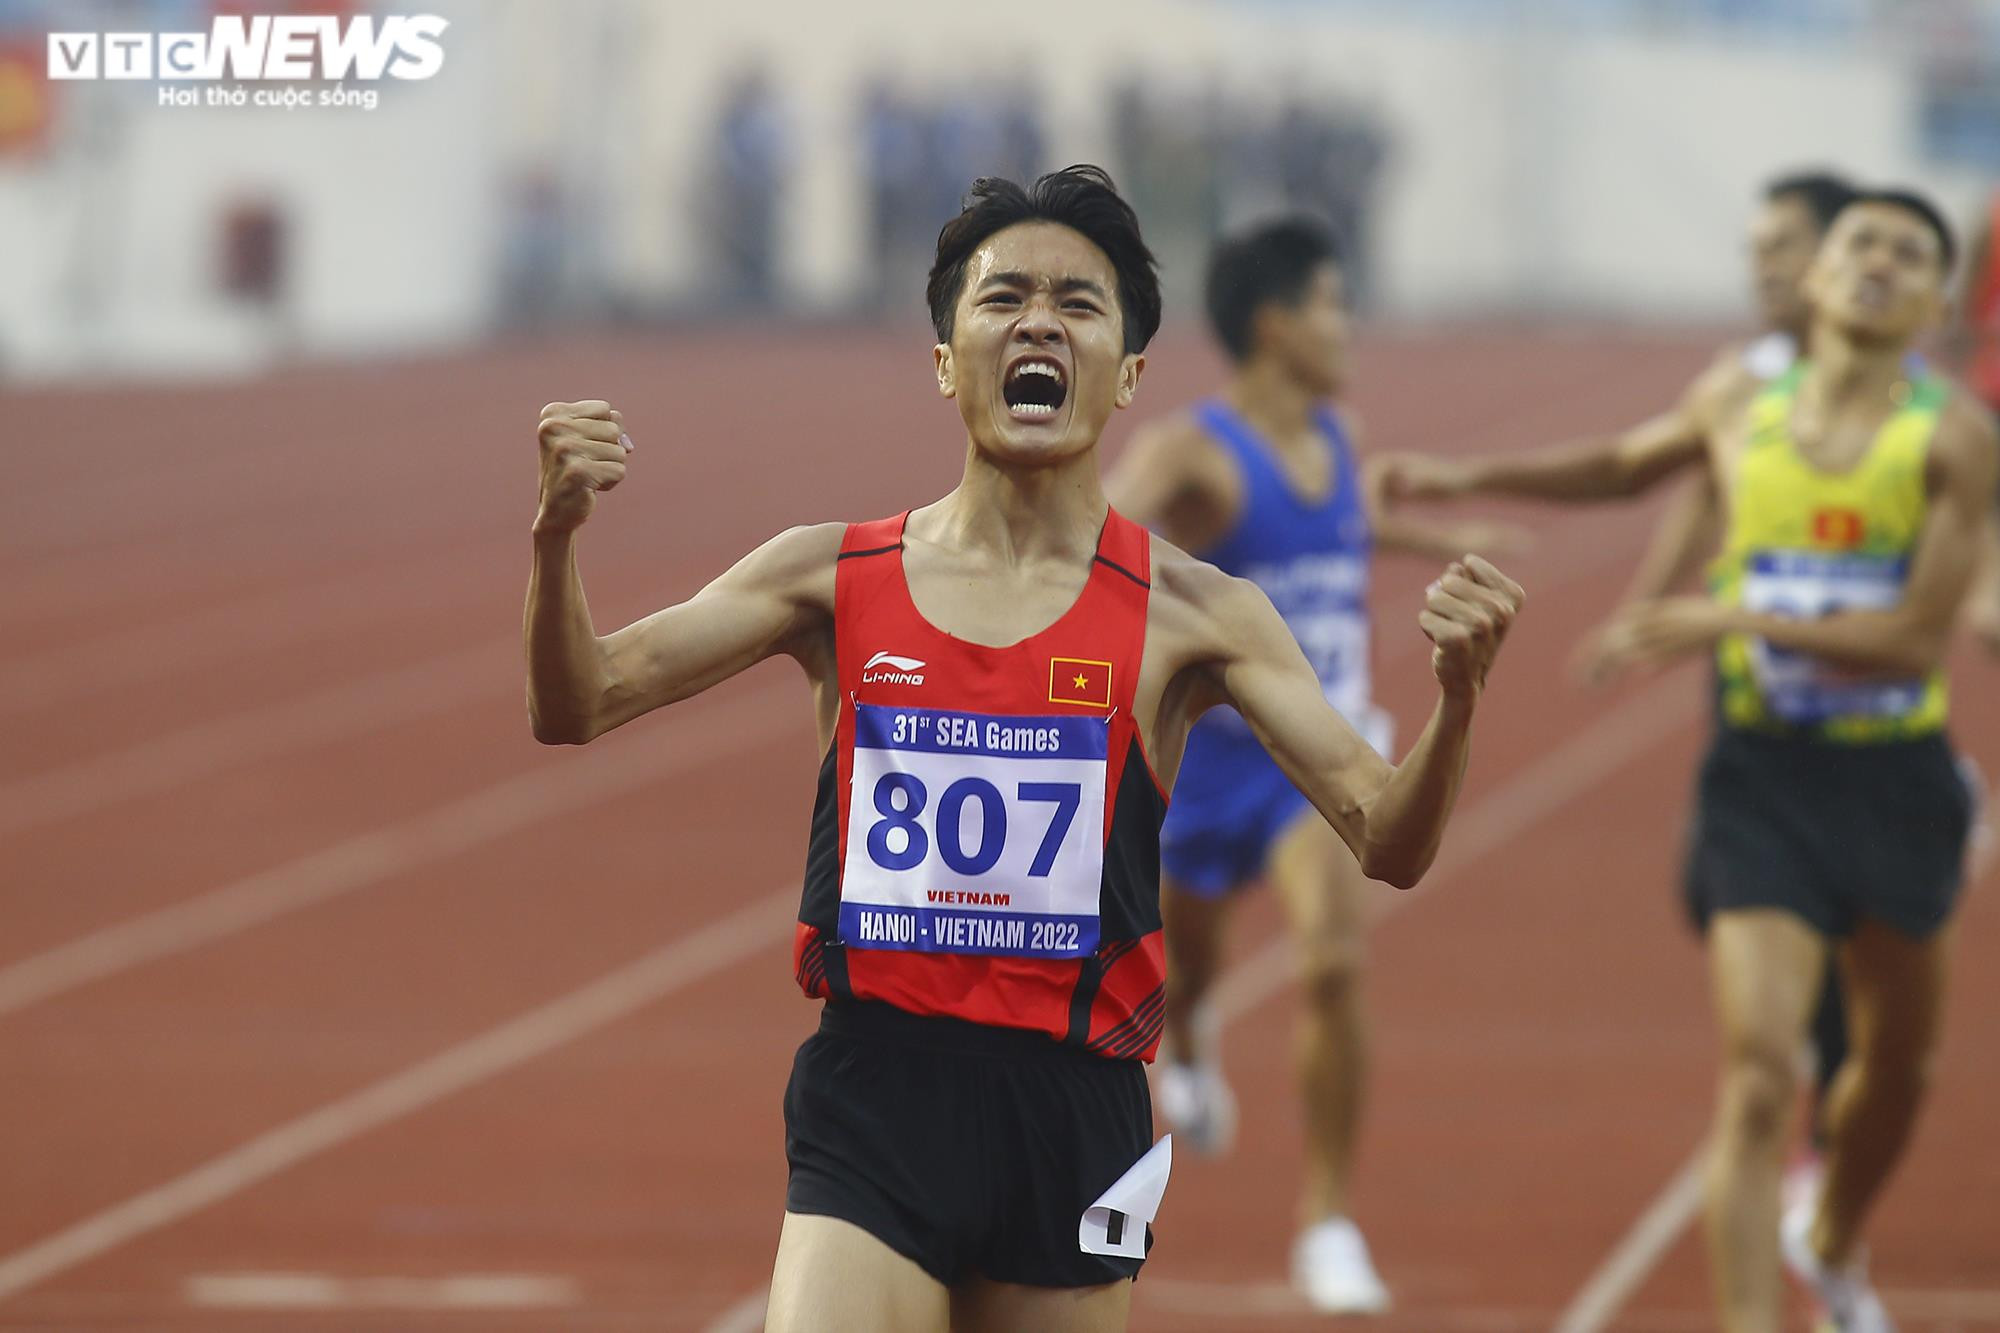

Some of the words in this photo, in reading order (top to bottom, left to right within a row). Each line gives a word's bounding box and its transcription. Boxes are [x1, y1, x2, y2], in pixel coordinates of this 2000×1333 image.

[862, 672, 924, 685] LI-NING
[936, 718, 979, 747] SEA
[985, 722, 1060, 751] Games
[867, 772, 1081, 877] 807
[927, 889, 1010, 905] VIETNAM
[859, 911, 916, 943] HANOI
[935, 917, 1025, 950] VIETNAM
[1032, 922, 1079, 950] 2022
